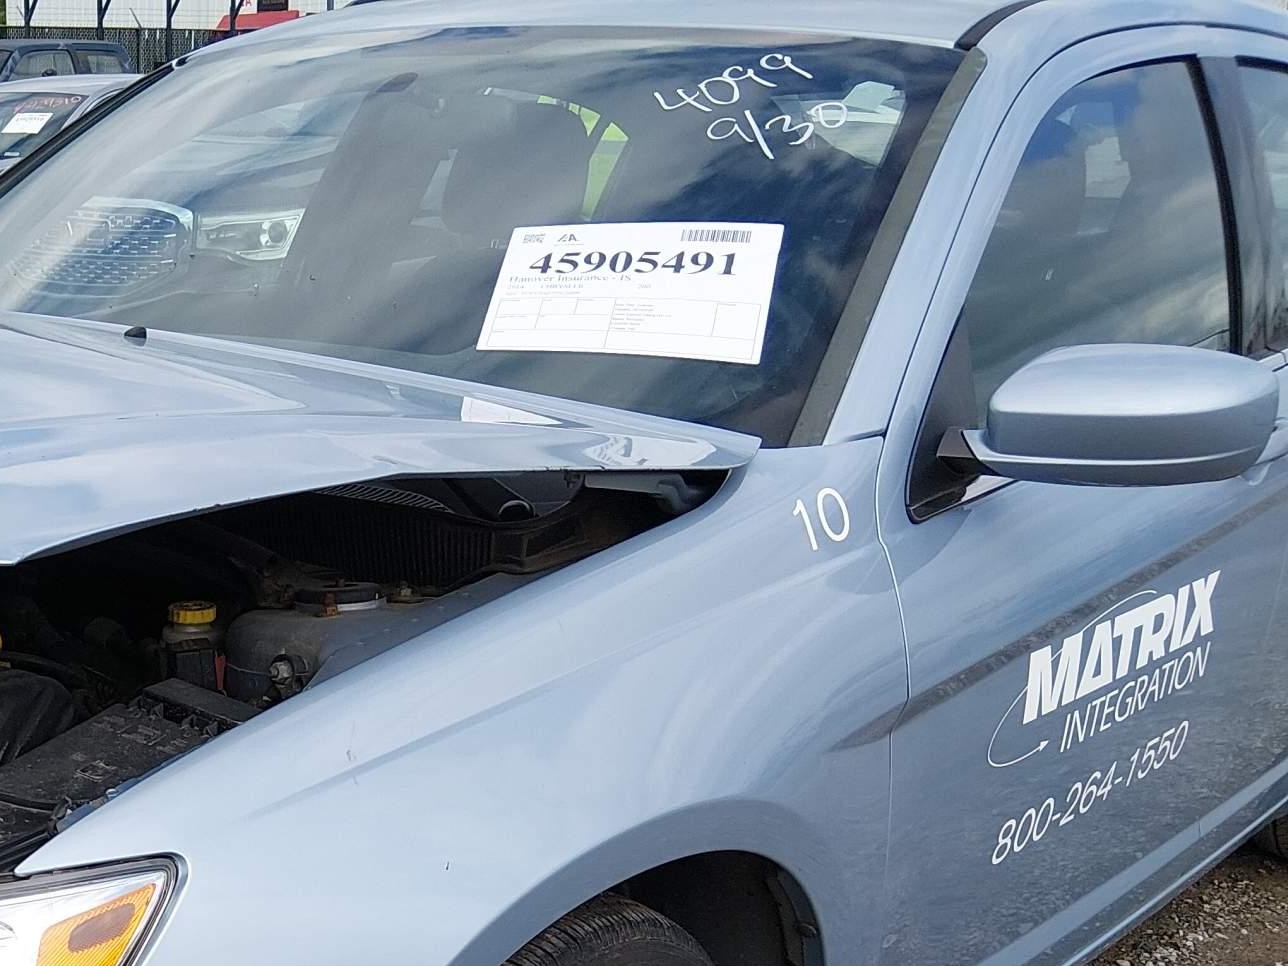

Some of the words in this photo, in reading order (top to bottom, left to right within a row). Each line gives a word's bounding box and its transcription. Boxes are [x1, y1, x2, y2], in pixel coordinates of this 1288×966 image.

[654, 53, 814, 112] 4099
[706, 102, 848, 160] 9/30
[528, 250, 737, 276] 45905491
[792, 487, 850, 551] 10
[1022, 569, 1221, 726] MATRIX
[1060, 642, 1212, 753] INTEGRATION
[990, 720, 1190, 866] 800-264-1550
